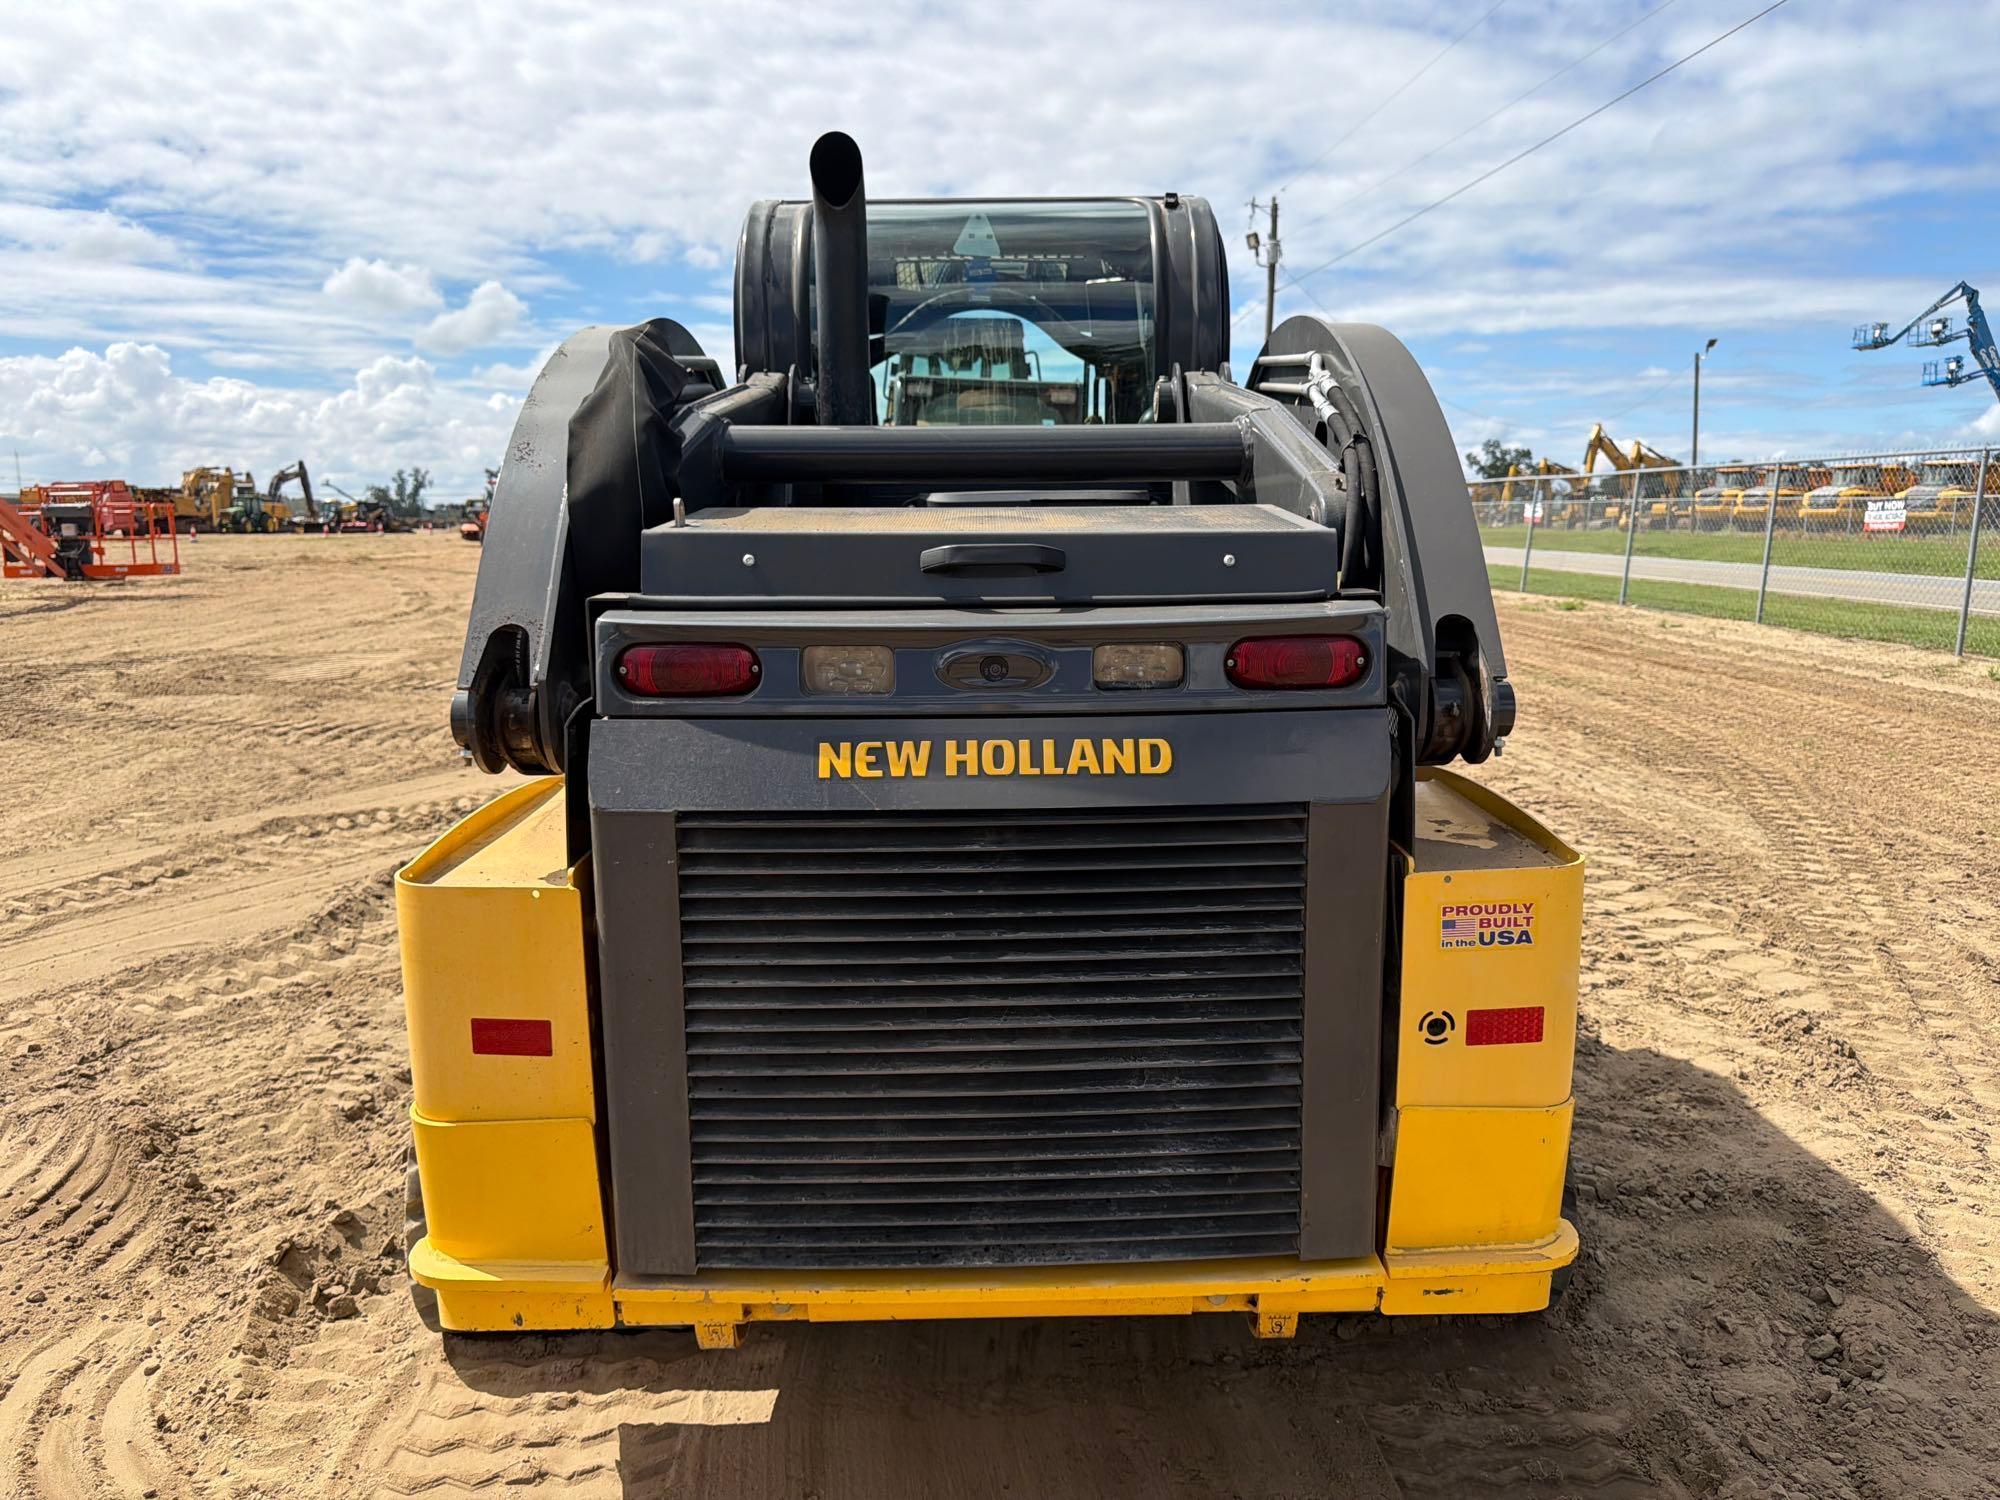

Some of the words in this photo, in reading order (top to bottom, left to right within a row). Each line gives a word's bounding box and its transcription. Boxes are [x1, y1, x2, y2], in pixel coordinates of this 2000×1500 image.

[1884, 500, 1905, 510] NOW
[818, 739, 931, 778] NEW
[945, 738, 1173, 776] HOLLAND
[1442, 903, 1534, 916] PROUDLY
[1479, 917, 1534, 928] BUILT
[1455, 939, 1476, 947] the
[1479, 930, 1533, 946] USA
